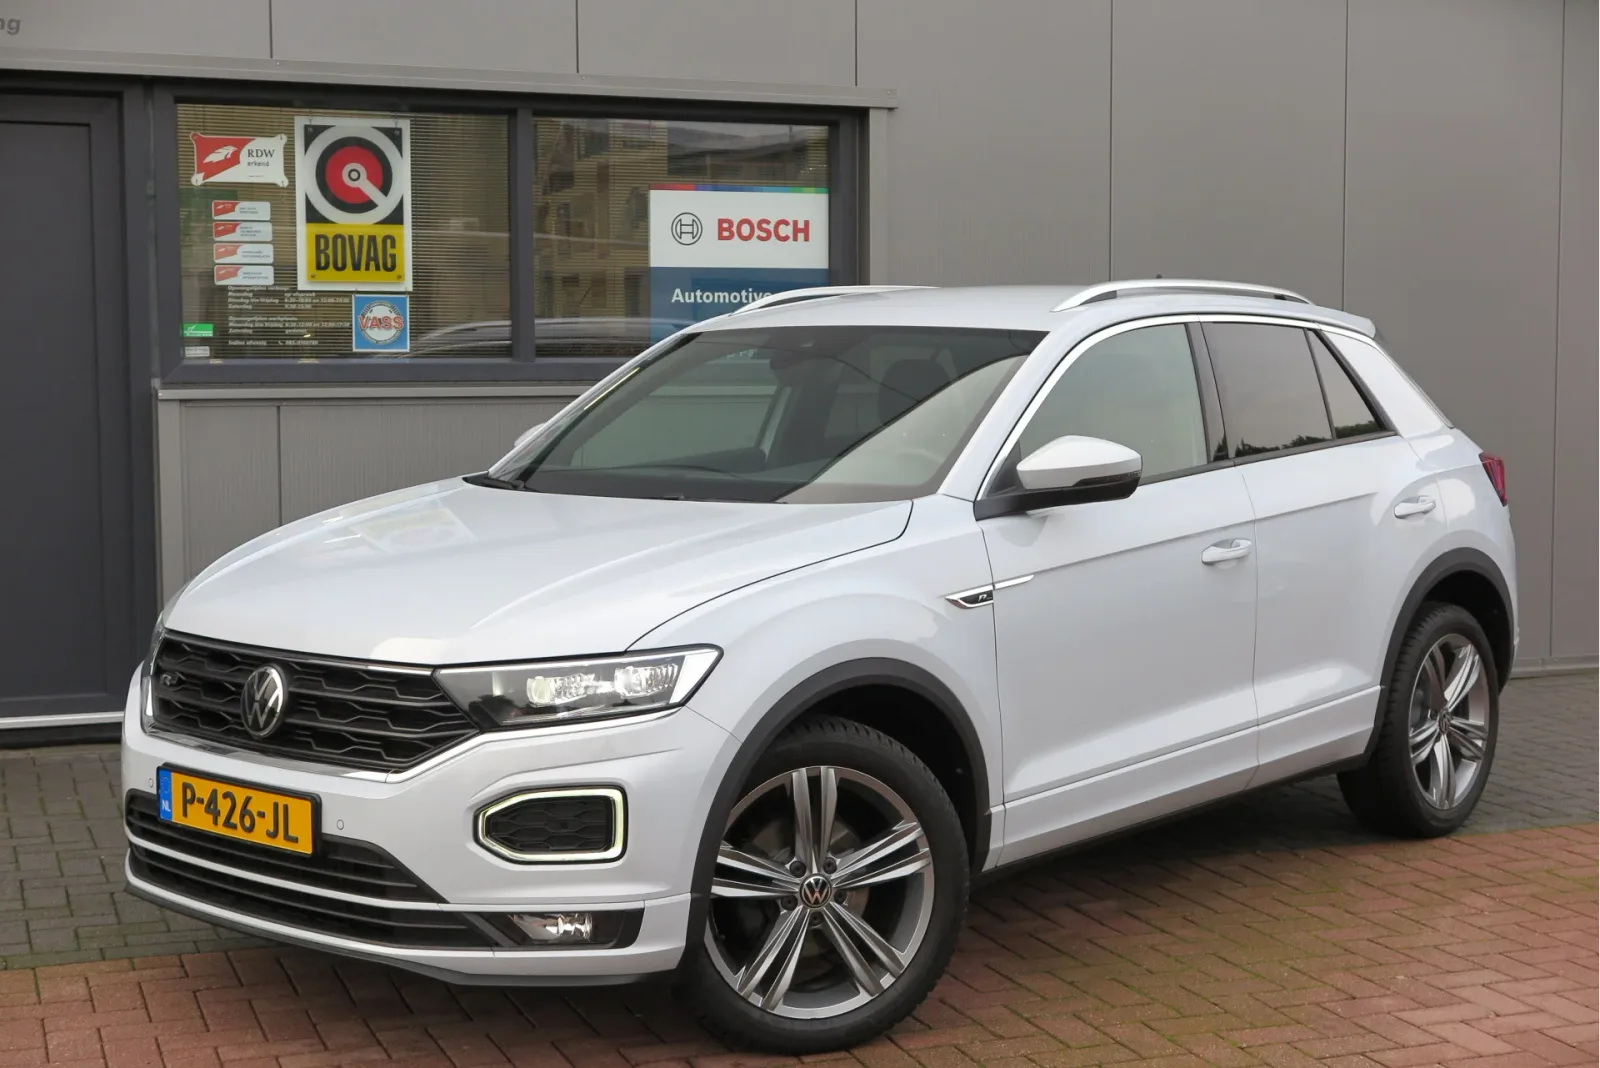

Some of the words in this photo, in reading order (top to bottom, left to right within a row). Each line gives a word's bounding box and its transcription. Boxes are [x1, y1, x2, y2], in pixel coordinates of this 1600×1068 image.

[247, 148, 275, 158] RDW
[717, 218, 810, 242] BOSCH
[315, 233, 397, 272] BOVAG
[357, 315, 404, 331] VASS
[162, 799, 171, 812] NL
[181, 781, 299, 844] P-426-JL
